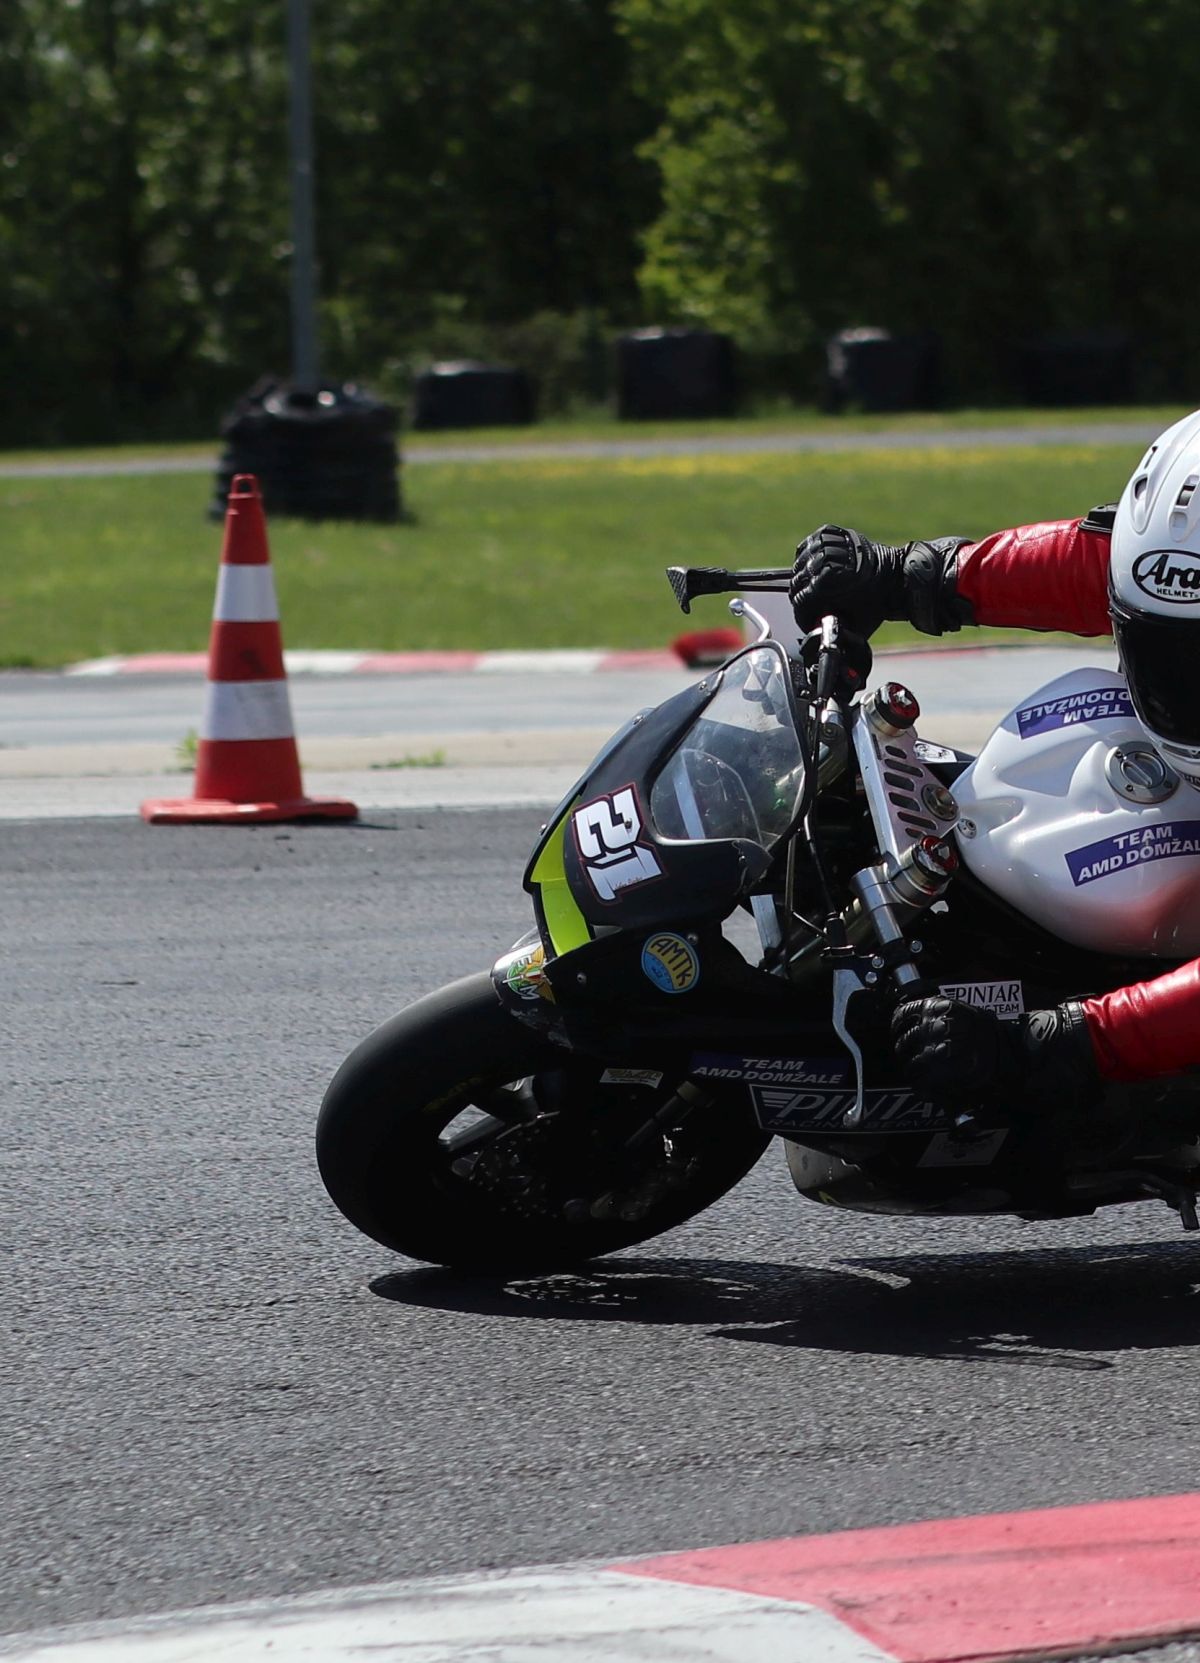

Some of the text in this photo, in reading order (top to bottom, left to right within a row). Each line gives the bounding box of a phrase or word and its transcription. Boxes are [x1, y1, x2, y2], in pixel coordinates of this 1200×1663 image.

[1156, 588, 1194, 598] HELMET
[1020, 691, 1115, 722] DOMŽALE
[1063, 704, 1125, 723] TEAM
[573, 785, 665, 903] 21
[1113, 826, 1172, 850] TEAM
[1078, 855, 1123, 882] AMD
[651, 939, 693, 986] AMTK
[955, 984, 1020, 1004] PINTAR
[995, 1004, 1020, 1013] TEAM
[691, 1066, 843, 1084] AMD DOMŽALE
[741, 1058, 804, 1070] TEAM
[776, 1094, 944, 1120] PINTA
